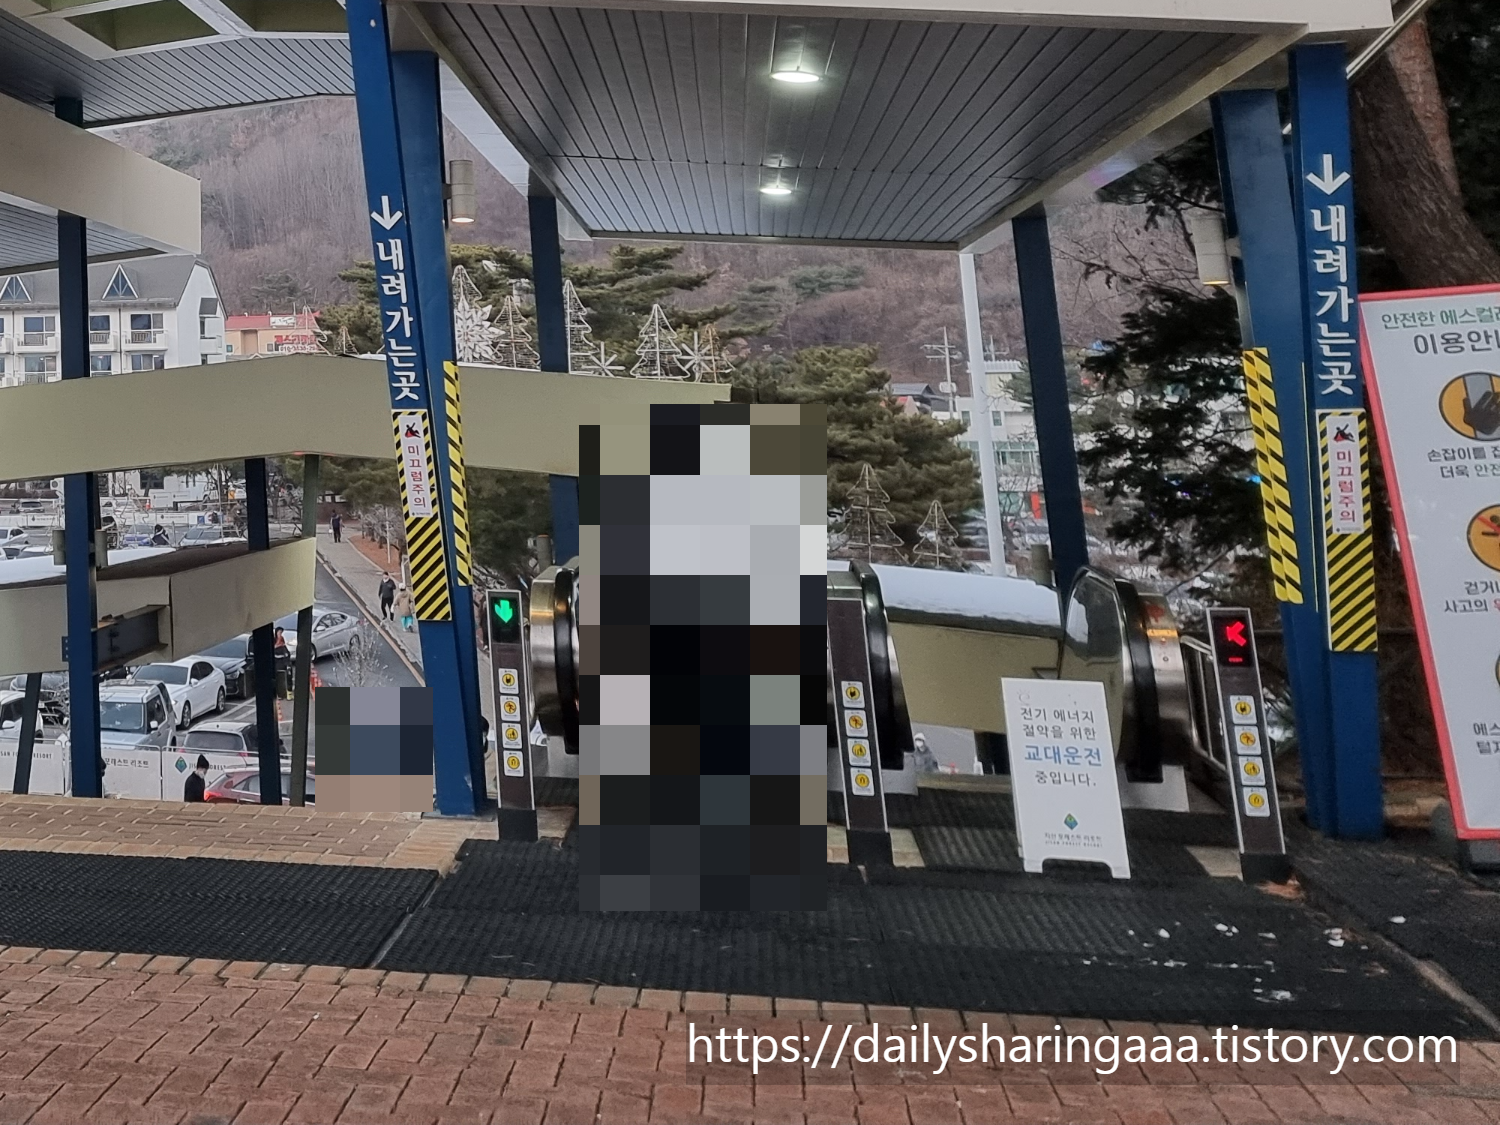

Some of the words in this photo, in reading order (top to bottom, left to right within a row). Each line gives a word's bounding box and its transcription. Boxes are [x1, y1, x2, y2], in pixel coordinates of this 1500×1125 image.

[1381, 311, 1436, 329] 안전한
[1414, 330, 1500, 355] 이용안
[1427, 446, 1487, 462] 손잡이를
[1444, 598, 1489, 613] 사고의
[1020, 707, 1047, 721] 전기
[1053, 708, 1095, 724] 에너지
[1022, 724, 1064, 739] 절약을
[1070, 726, 1097, 741] 위한
[1024, 744, 1102, 767] 교대운전
[1034, 770, 1097, 787] 중입니다.
